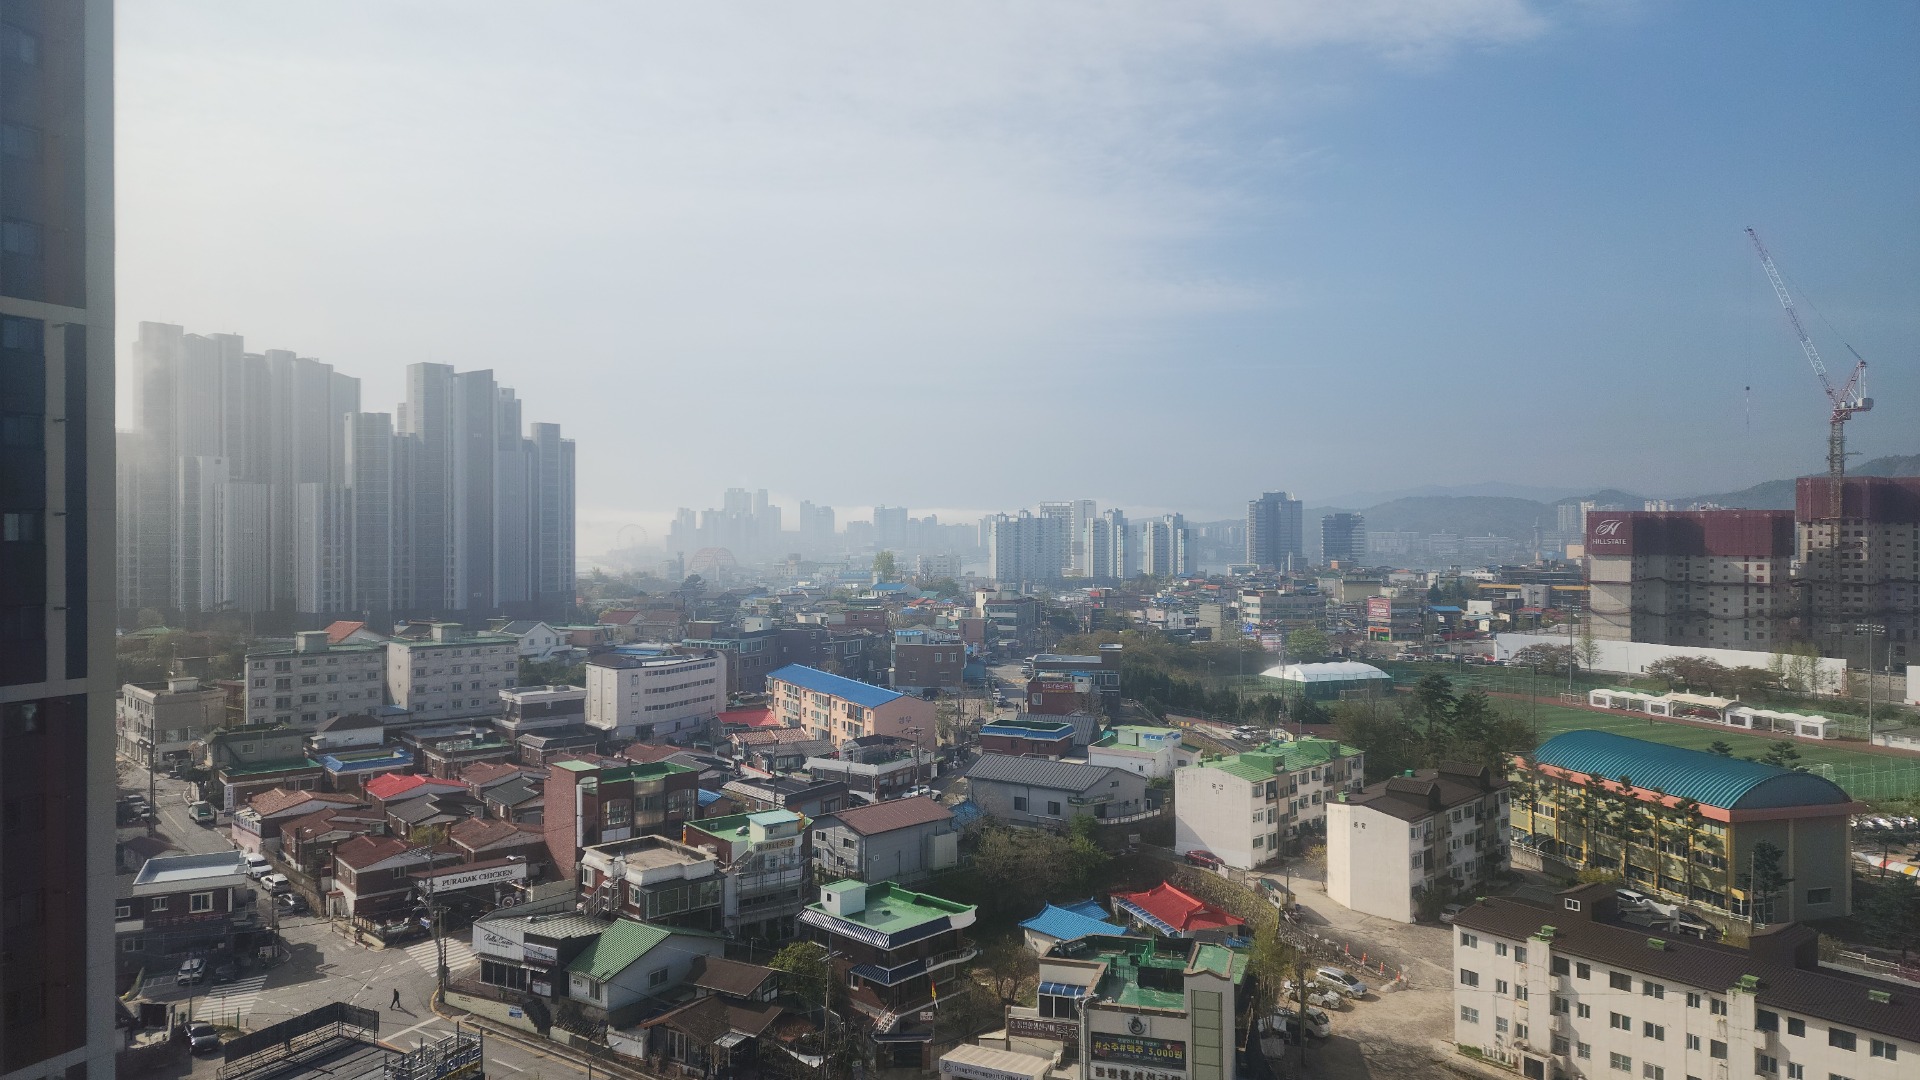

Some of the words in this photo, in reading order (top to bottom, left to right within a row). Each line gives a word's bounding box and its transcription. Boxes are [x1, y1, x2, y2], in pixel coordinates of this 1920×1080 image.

[441, 874, 478, 887] PURADAK
[478, 869, 513, 882] CHICKEN
[1095, 1040, 1144, 1054] #소주#맥주
